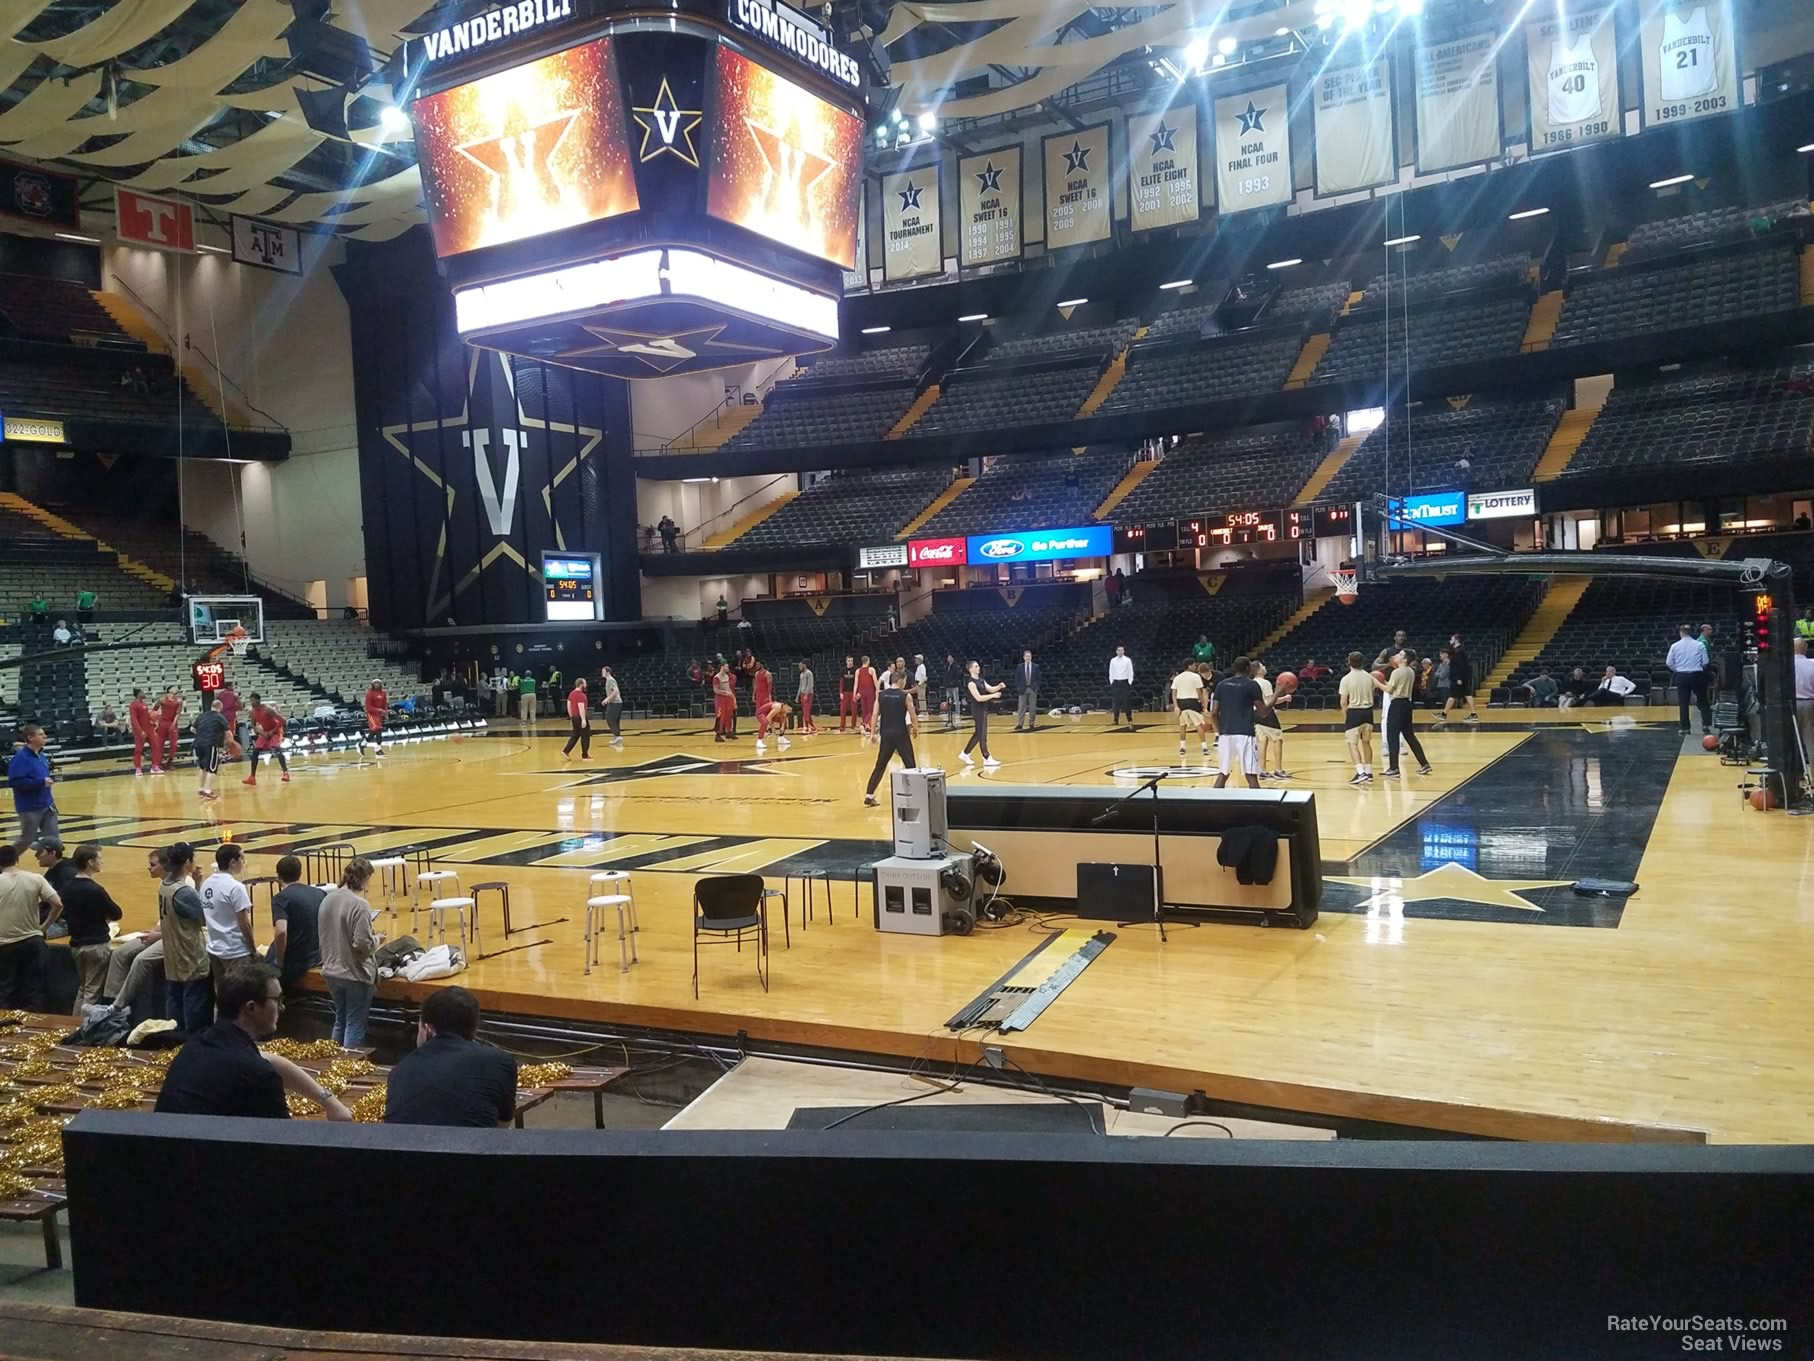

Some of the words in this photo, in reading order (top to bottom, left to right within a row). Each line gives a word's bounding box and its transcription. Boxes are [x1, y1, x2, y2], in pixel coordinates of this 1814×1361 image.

[737, 0, 861, 87] COMMODORES
[1663, 35, 1711, 54] VANDERBILT
[1676, 48, 1698, 69] 21
[1562, 74, 1585, 94] 40
[1245, 111, 1257, 127] V
[653, 110, 681, 144] V
[1158, 131, 1168, 146] V
[1241, 142, 1264, 156] NCAA
[1071, 151, 1081, 166] V
[1228, 157, 1252, 172] FINAL
[1255, 151, 1278, 166] FOUR
[1153, 159, 1174, 173] NCAA
[985, 172, 994, 186] V
[1141, 173, 1161, 187] ELITE
[1164, 167, 1187, 182] EIGHT
[1067, 179, 1088, 192] NCAA
[1140, 186, 1160, 199] 1992
[1170, 180, 1191, 193] 1996
[1238, 176, 1269, 195] 1993
[906, 190, 915, 204] V
[1059, 190, 1083, 204] SWEET
[1086, 188, 1096, 199] 16
[1140, 199, 1160, 212] 2001
[1170, 194, 1192, 206] 2002
[981, 198, 1000, 211] NCAA
[1053, 205, 1074, 217] 2005
[136, 199, 176, 242] T
[902, 216, 920, 227] NCAA
[973, 210, 996, 223] SWEET
[999, 208, 1008, 218] 16
[968, 223, 987, 235] 1990
[995, 218, 1012, 230] 1991
[1053, 218, 1074, 231] 2009
[890, 223, 934, 241] TOURNAMENT
[968, 236, 987, 248] 1994
[995, 230, 1014, 243] 1995
[890, 242, 909, 252] 2014
[968, 248, 987, 260] 1997
[995, 243, 1014, 255] 2004
[6, 423, 61, 437] 322-GOLD
[462, 428, 528, 536] V
[1485, 495, 1531, 509] LOTTERY
[1228, 512, 1260, 526] 54:05
[1290, 513, 1299, 523] 4
[1191, 522, 1199, 533] 4
[1291, 526, 1299, 538] 0
[1198, 534, 1206, 546] 0
[1223, 534, 1230, 545] 0
[1243, 534, 1248, 543] 1
[1267, 529, 1275, 541] 0
[1049, 537, 1089, 551] Further
[1707, 542, 1720, 555] E
[1207, 576, 1218, 588] C
[1007, 590, 1018, 600] B
[815, 600, 824, 609] A
[202, 673, 219, 688] 30
